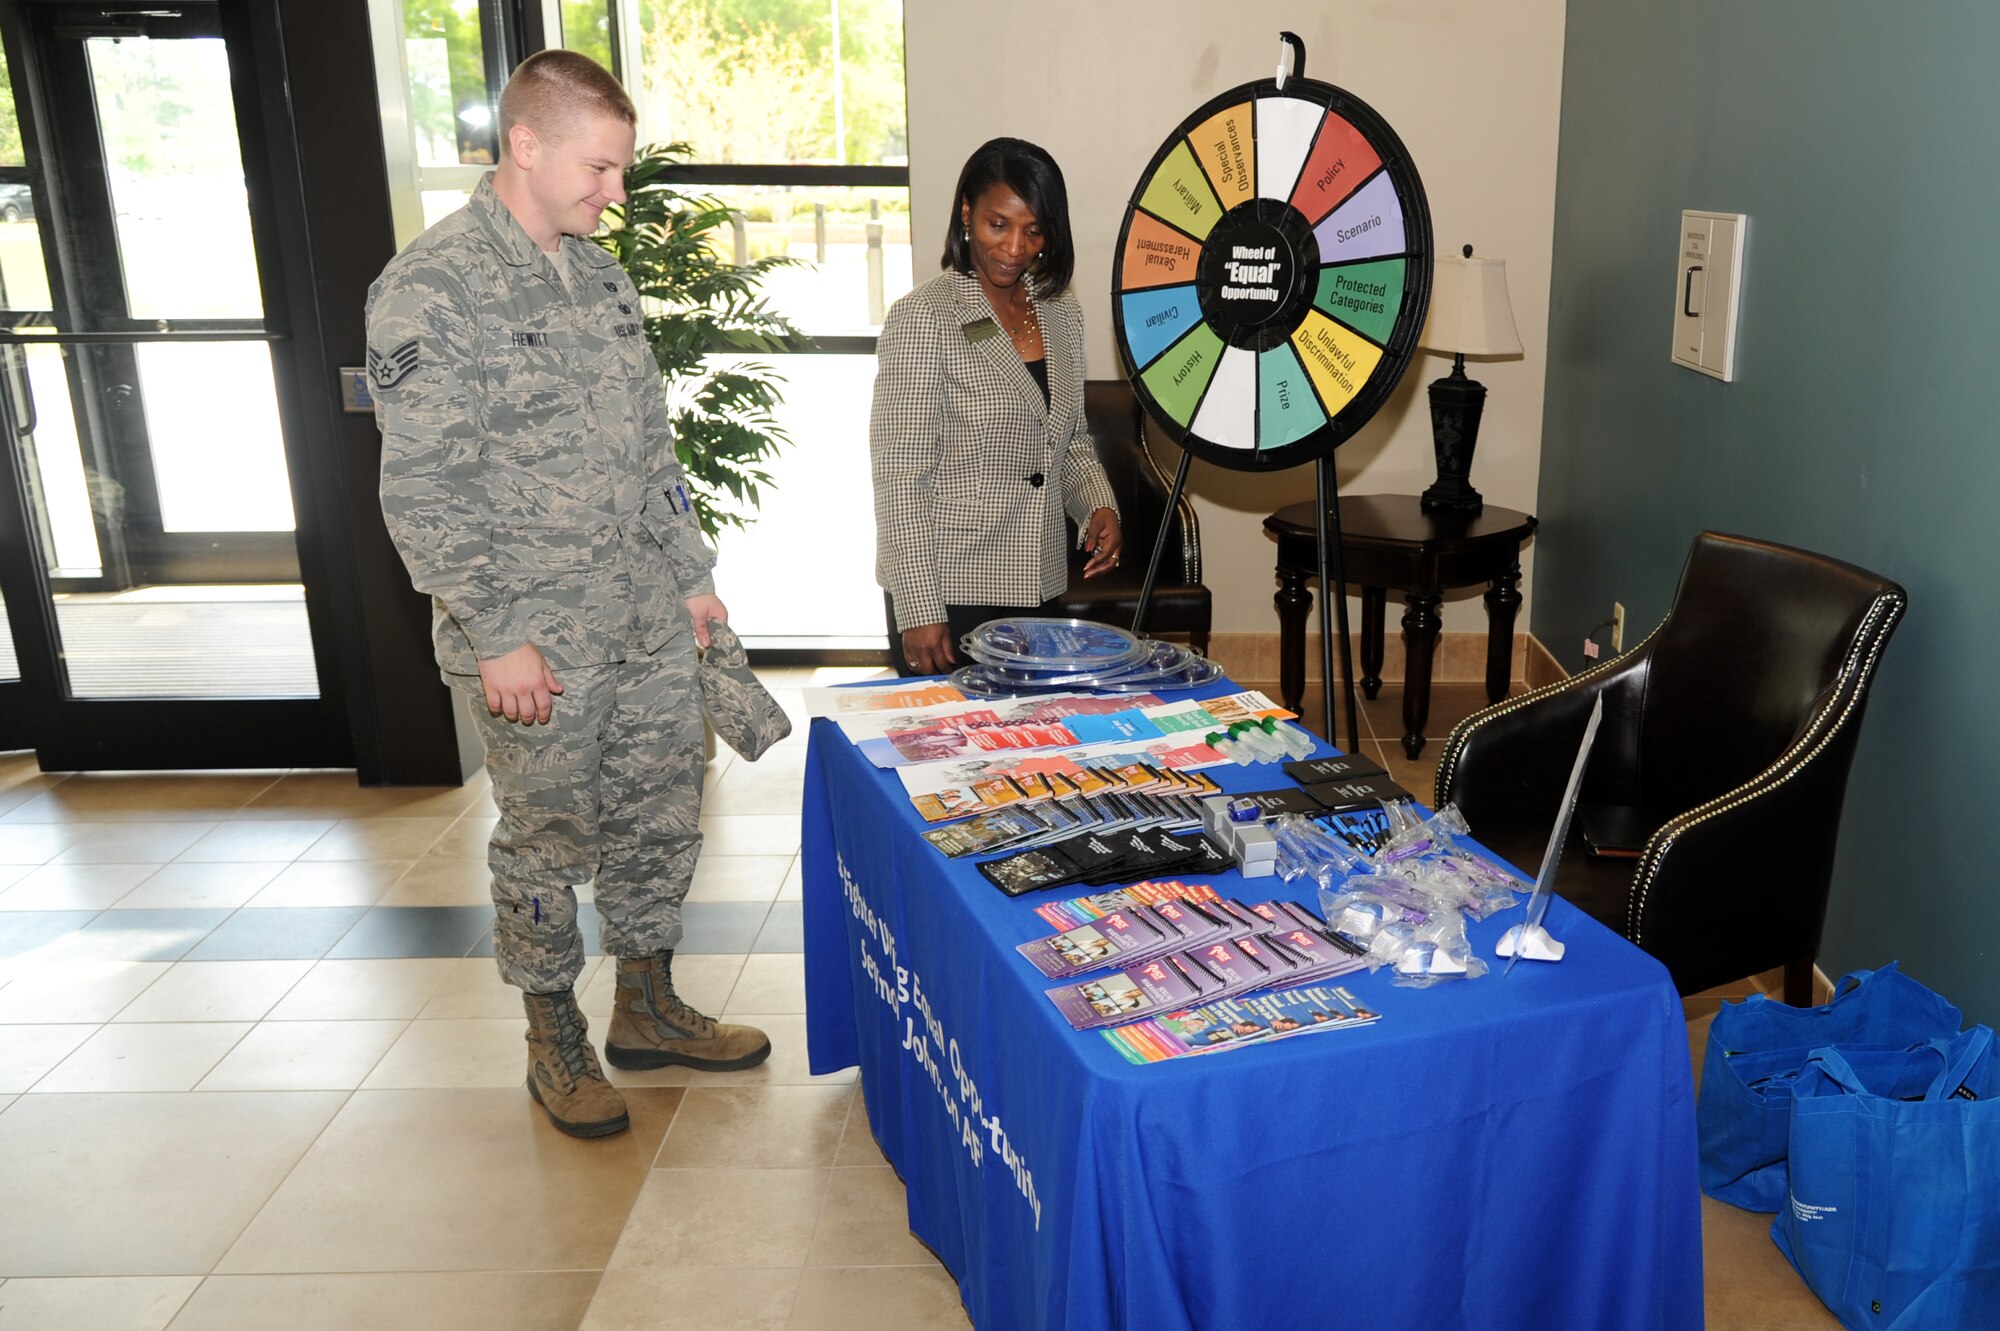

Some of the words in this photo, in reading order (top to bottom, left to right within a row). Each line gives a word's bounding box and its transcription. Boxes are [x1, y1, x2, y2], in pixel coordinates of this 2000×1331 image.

[1214, 143, 1233, 183] Special
[1225, 119, 1249, 192] Observances
[1317, 158, 1346, 192] Policy
[1171, 178, 1203, 215] Military
[1336, 215, 1382, 244] Scenario
[1136, 238, 1190, 260] Harassment
[1144, 253, 1176, 271] Sexual
[1232, 245, 1264, 259] Wheel
[1264, 246, 1276, 260] of
[1221, 285, 1279, 302] Opportunity
[1335, 275, 1386, 297] Protected
[1145, 304, 1179, 328] Civilian
[1330, 291, 1385, 314] Categories
[512, 332, 548, 347] HEWITT
[1317, 327, 1355, 372] Unlawful
[1172, 350, 1203, 388] History
[1298, 329, 1354, 394] Discrimination
[1276, 380, 1290, 411] Prize
